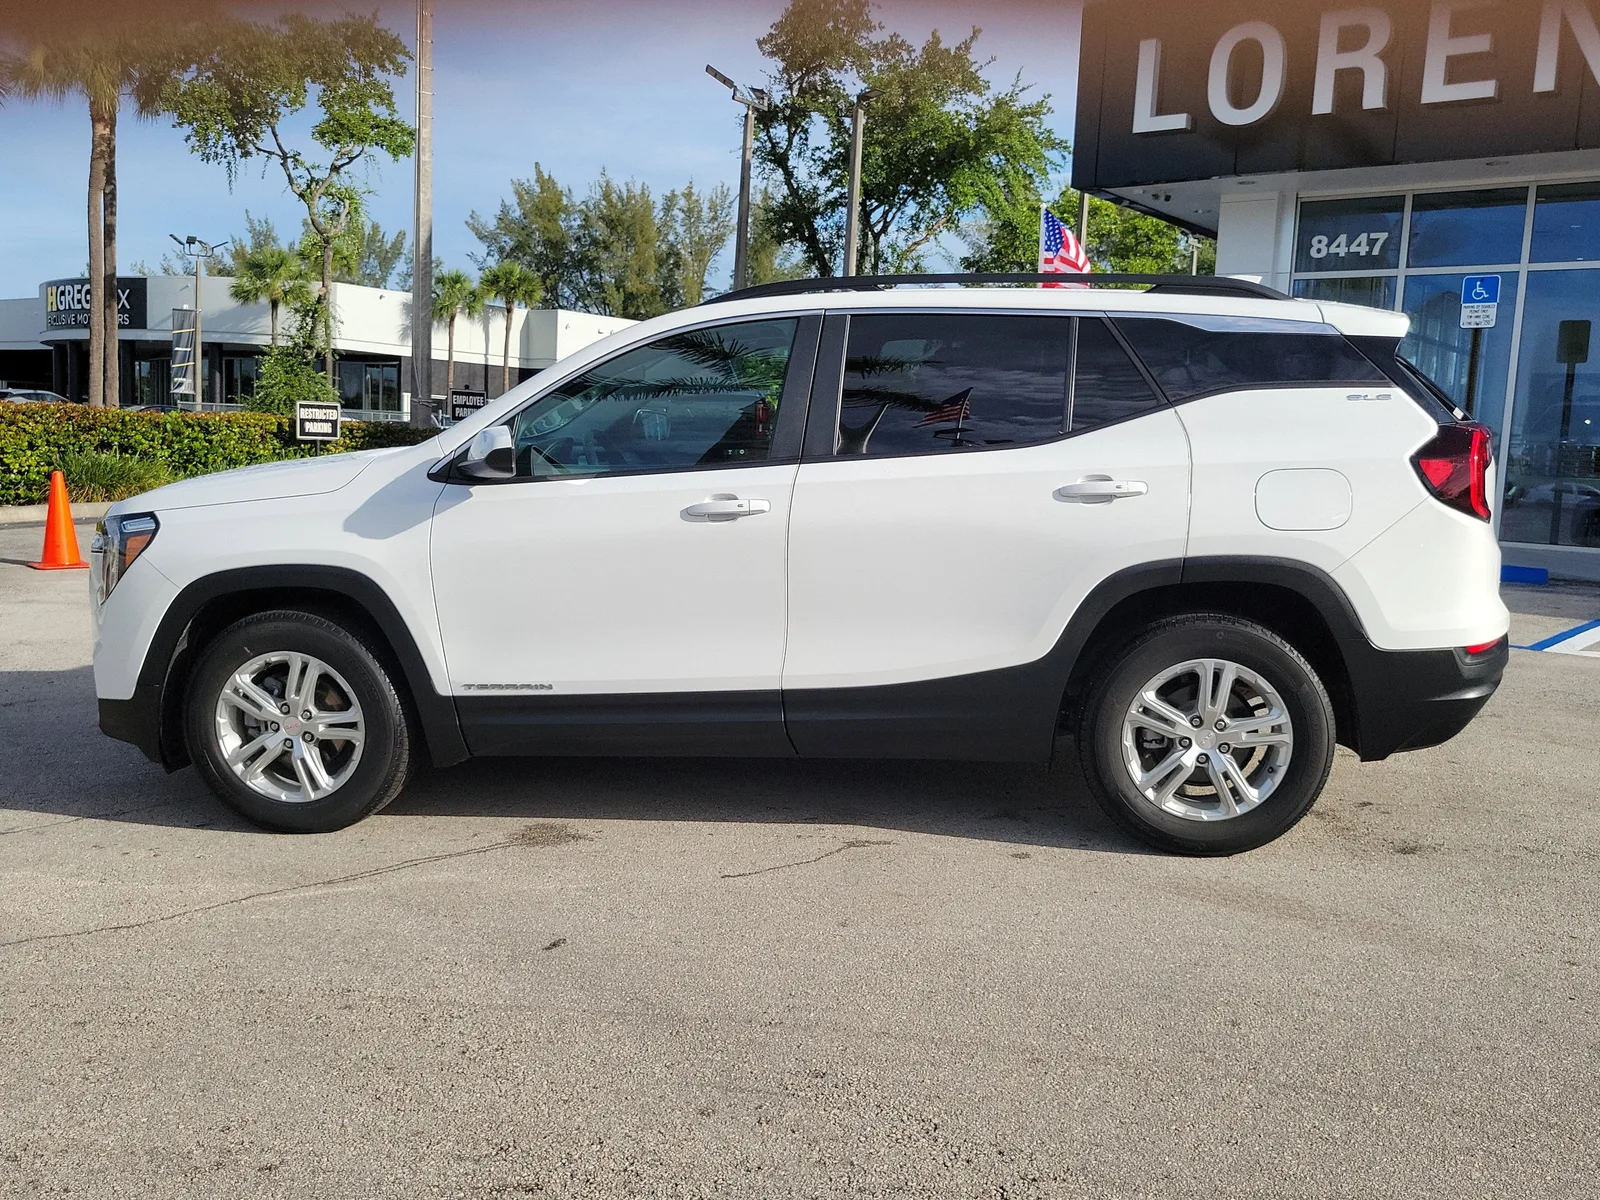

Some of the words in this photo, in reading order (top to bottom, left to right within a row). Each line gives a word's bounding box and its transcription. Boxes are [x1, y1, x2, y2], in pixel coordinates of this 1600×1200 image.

[1310, 231, 1389, 259] 8447
[47, 284, 131, 312] HGREGX
[48, 313, 76, 326] EXCLUSIVE
[452, 394, 484, 406] EMPLOYEE
[300, 407, 338, 420] RESTRICTED
[304, 421, 332, 433] PARKING
[460, 683, 553, 691] TERRAIN
